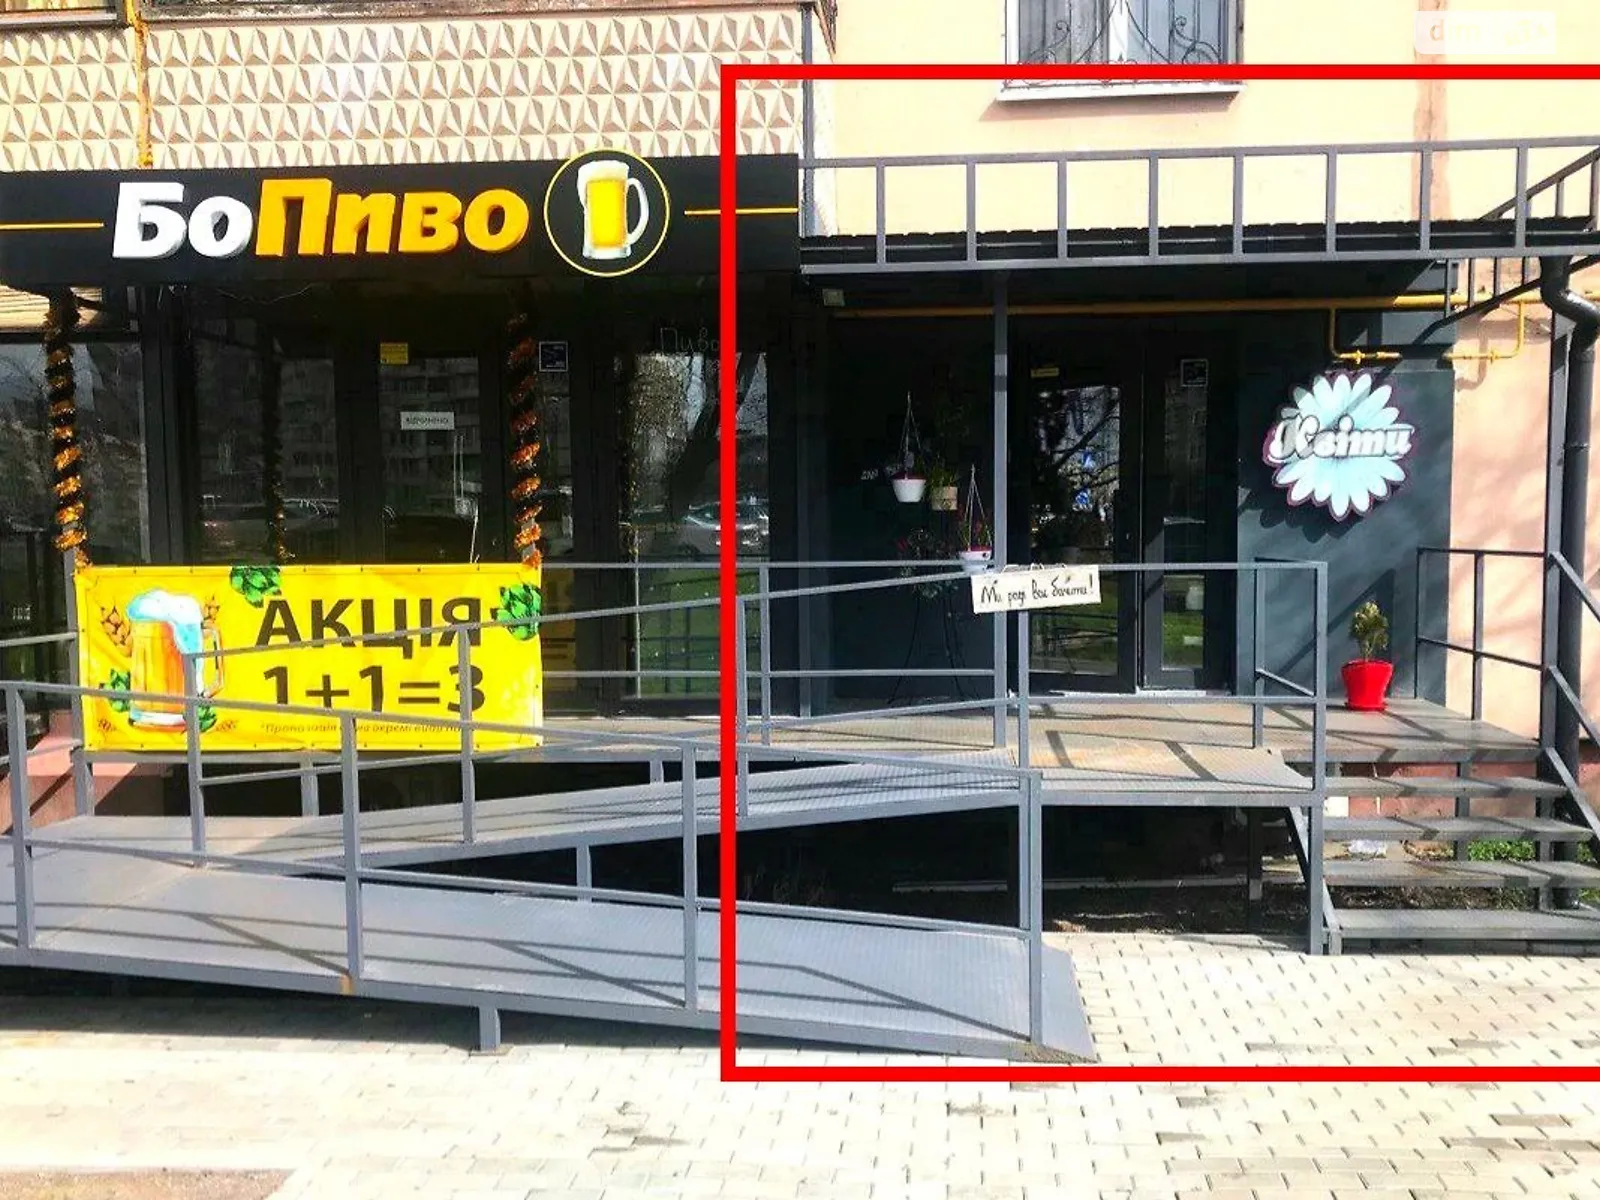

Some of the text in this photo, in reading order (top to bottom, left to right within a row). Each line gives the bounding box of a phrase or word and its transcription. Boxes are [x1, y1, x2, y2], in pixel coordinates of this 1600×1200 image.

[112, 177, 530, 259] БоПиво
[1267, 413, 1415, 462] Квіти
[980, 580, 1002, 603] Ми
[263, 664, 485, 714] 1+1=3
